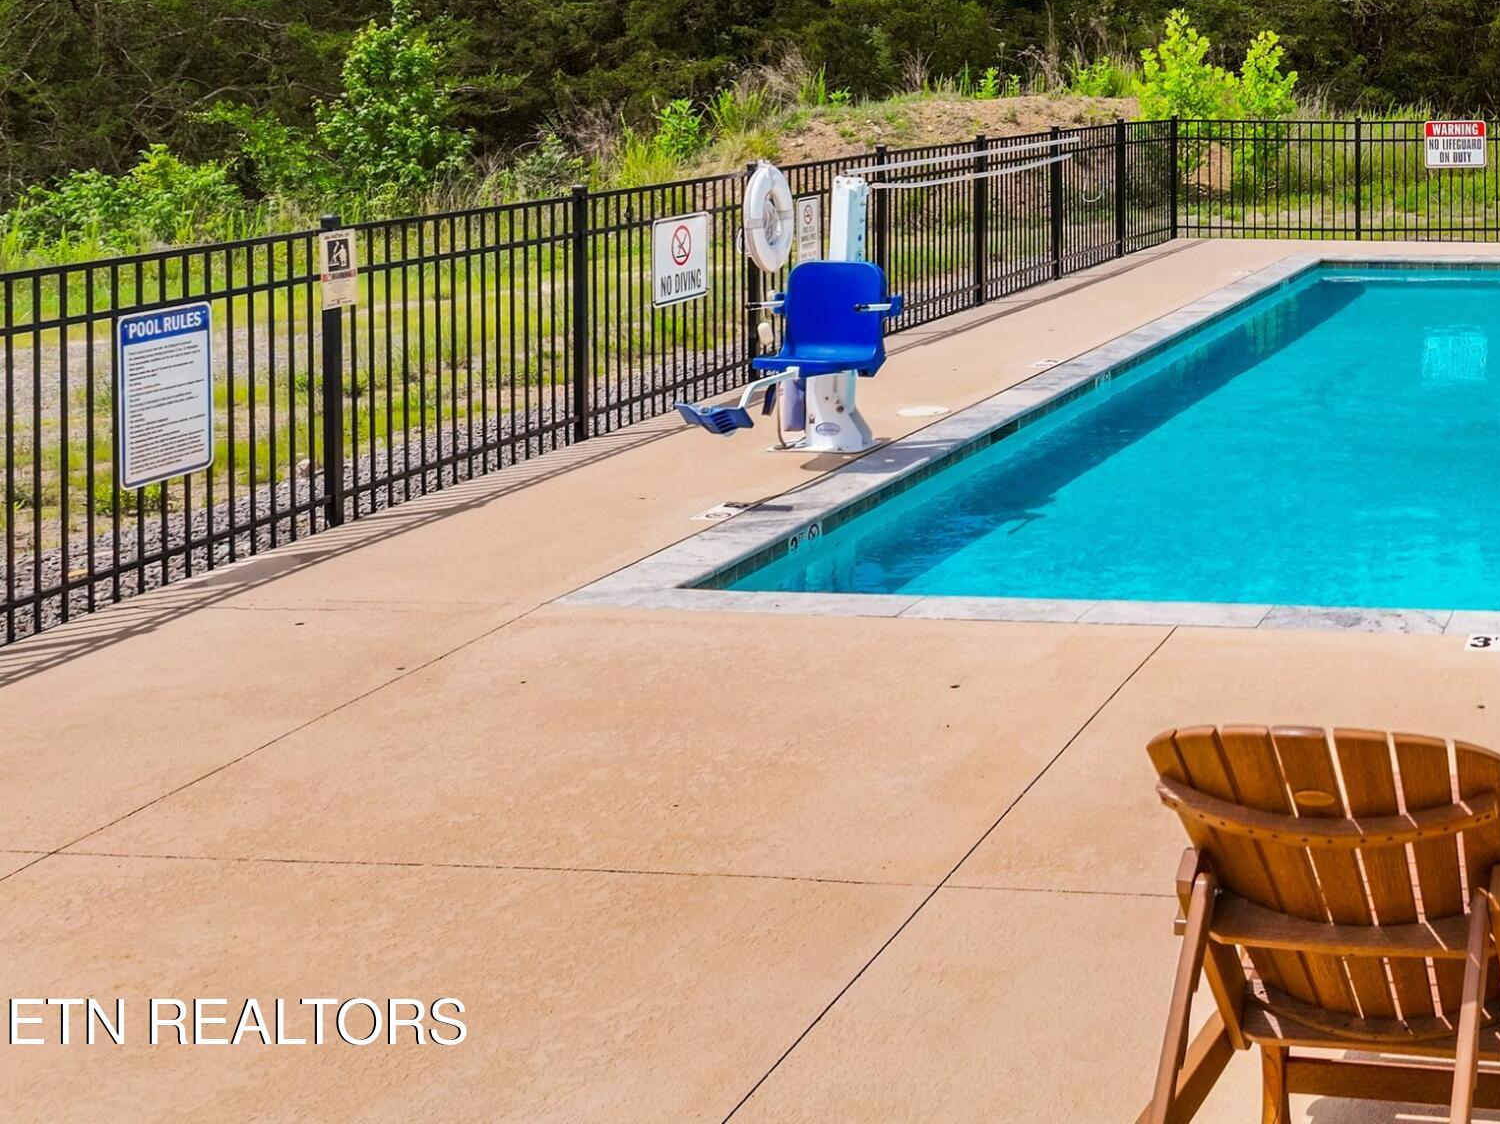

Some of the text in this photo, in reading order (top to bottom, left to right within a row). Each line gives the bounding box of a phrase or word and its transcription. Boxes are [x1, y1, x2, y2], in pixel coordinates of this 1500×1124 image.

[1432, 123, 1478, 136] WARNING
[1429, 138, 1482, 150] NO LIFEGUARD
[1439, 151, 1472, 163] ON DUTY
[660, 268, 702, 297] NO DIVING
[128, 311, 202, 339] POOL RULES
[1470, 636, 1492, 648] 3
